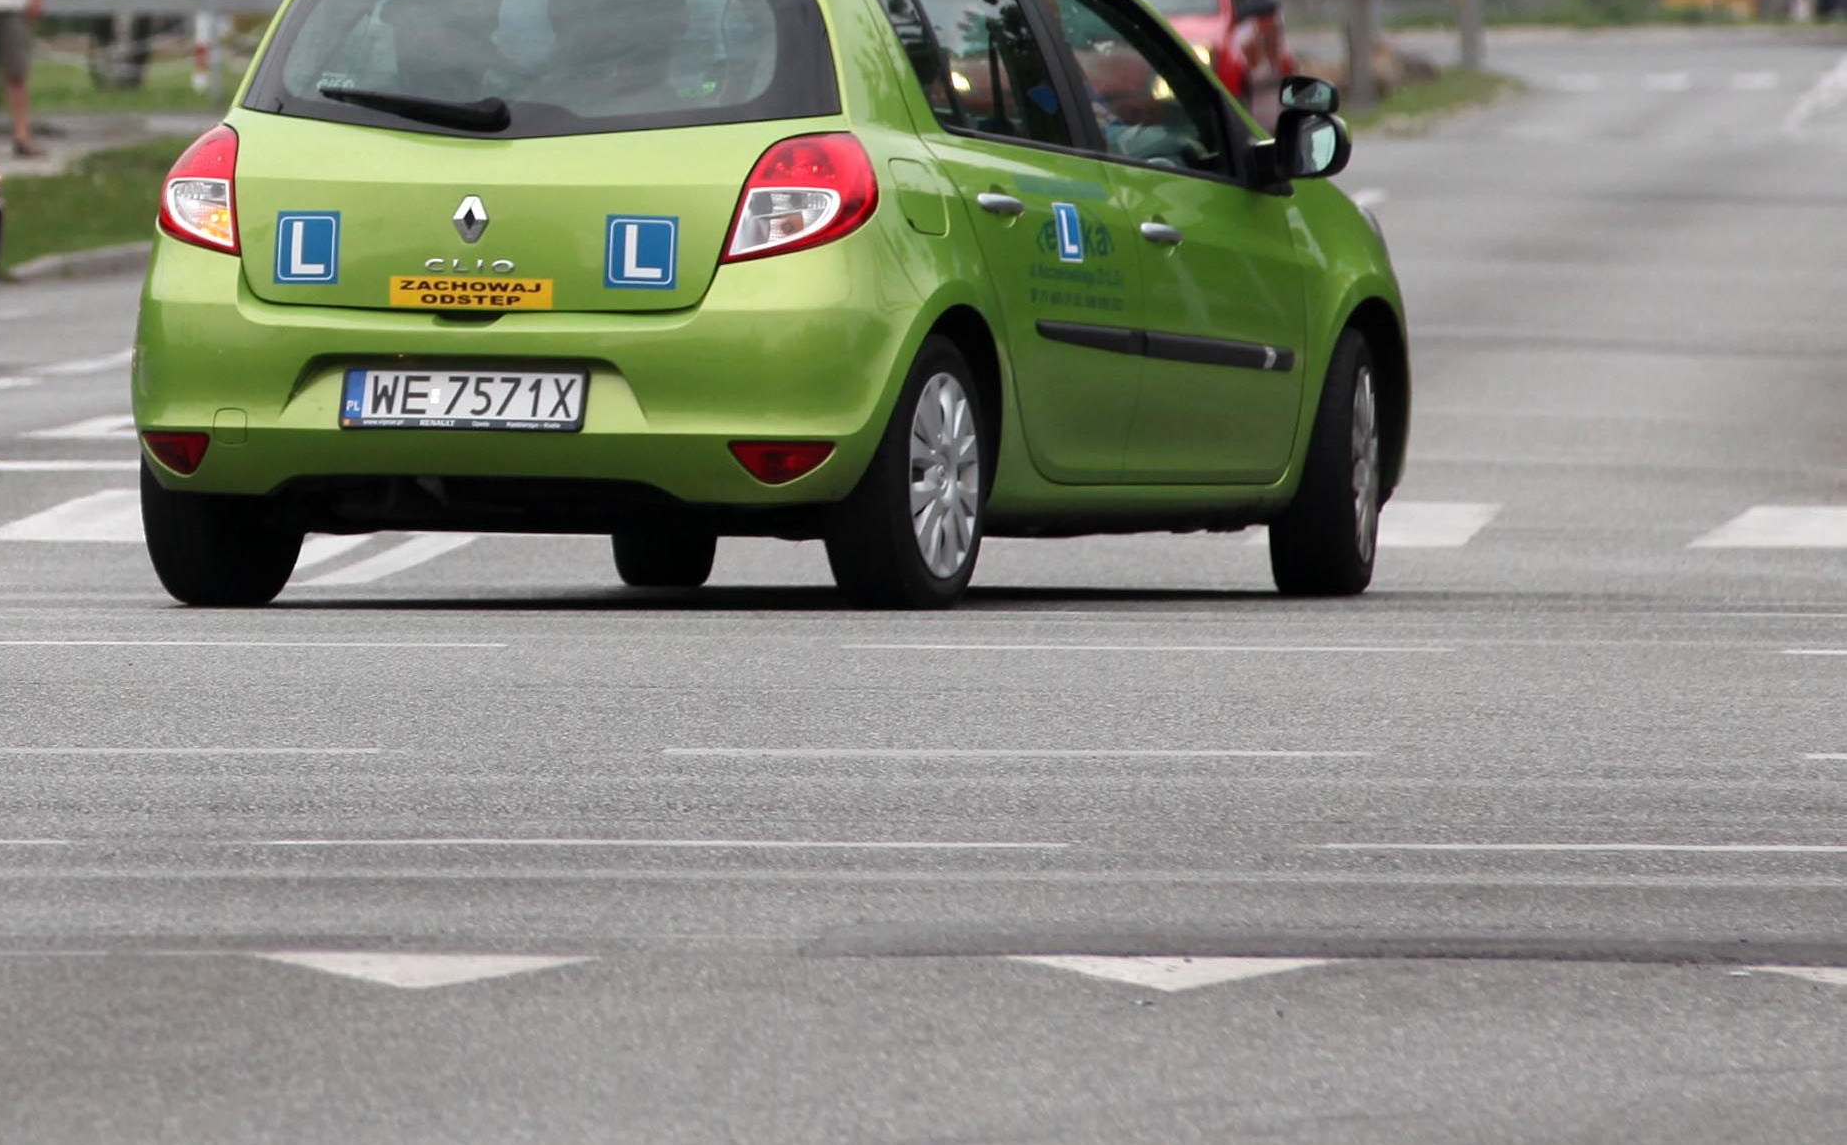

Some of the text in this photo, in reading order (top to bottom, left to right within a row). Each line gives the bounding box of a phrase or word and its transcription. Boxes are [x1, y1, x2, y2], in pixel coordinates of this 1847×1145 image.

[290, 221, 325, 276] L
[624, 223, 663, 279] L
[424, 258, 516, 273] CLIO
[399, 279, 542, 293] ZACHOWAJ
[345, 400, 361, 412] PL
[370, 374, 577, 419] WE 7571X
